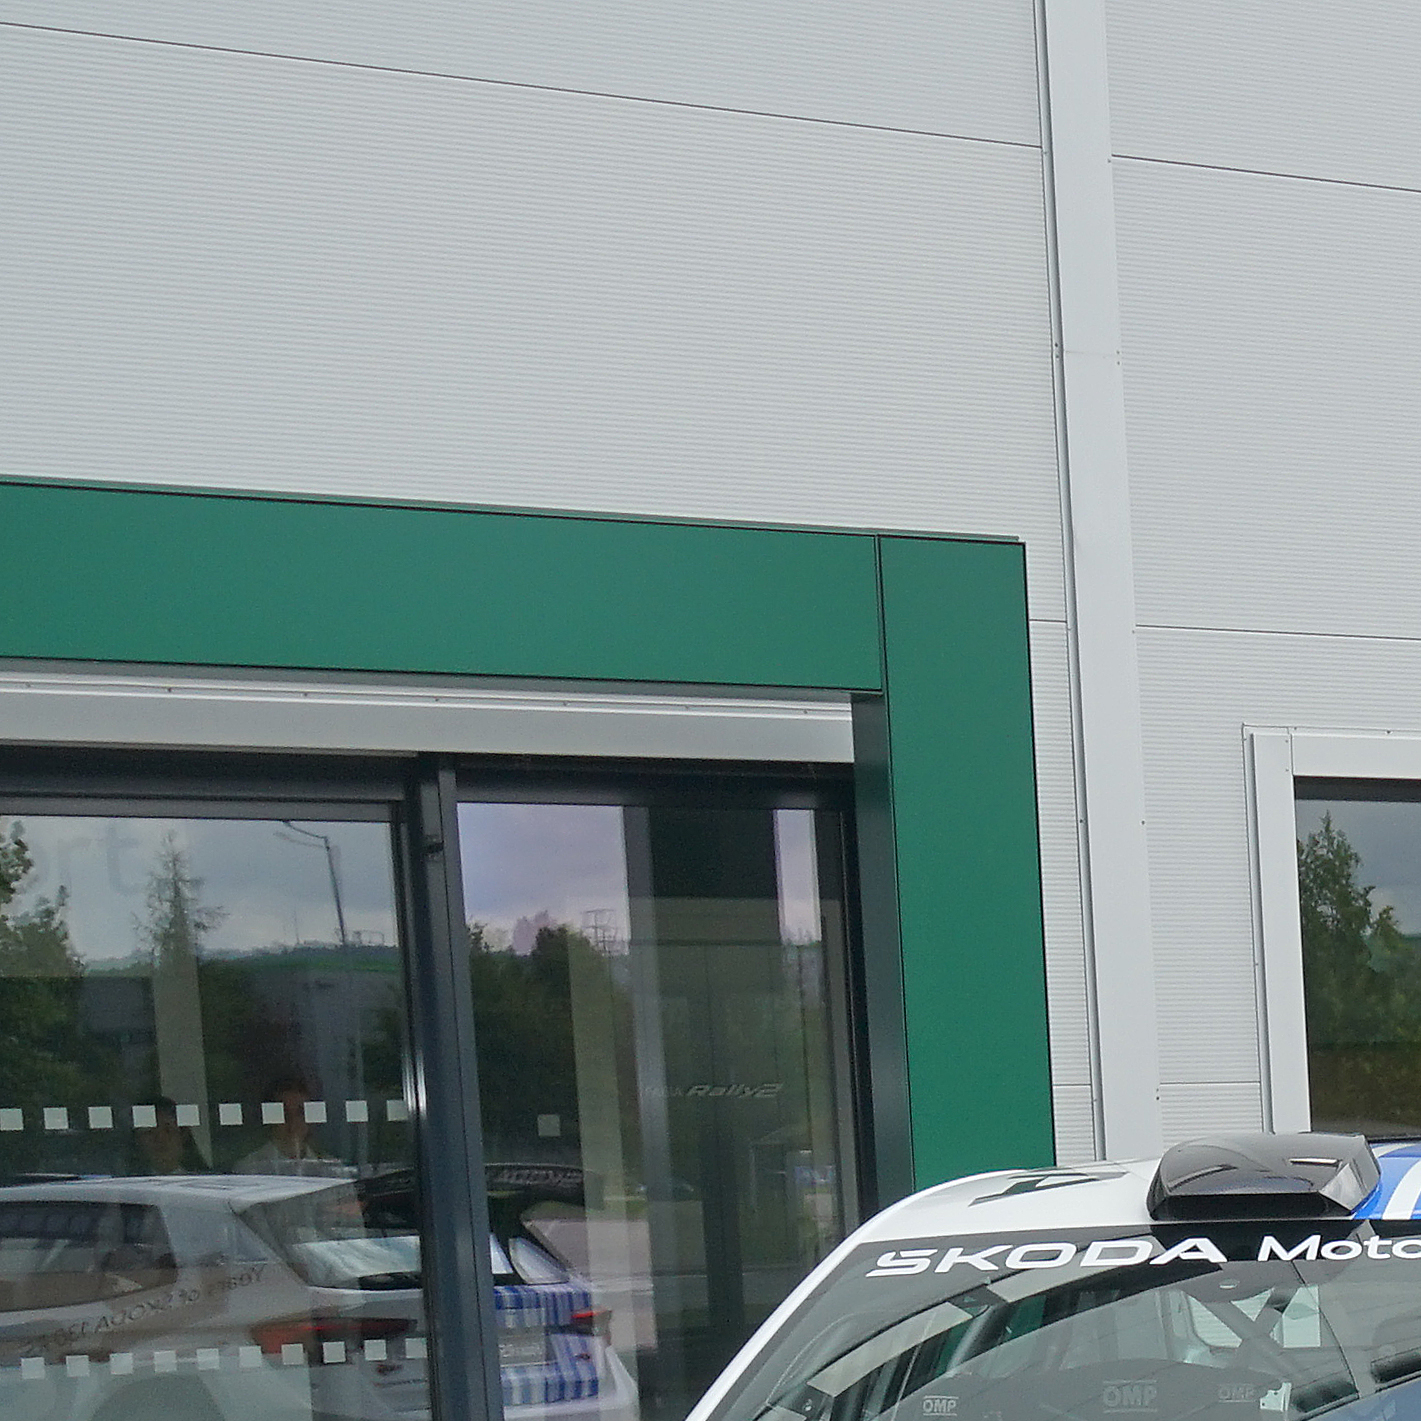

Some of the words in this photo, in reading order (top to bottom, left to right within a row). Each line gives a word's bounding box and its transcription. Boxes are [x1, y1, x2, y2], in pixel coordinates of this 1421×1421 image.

[1103, 1384, 1158, 1408] OMP
[1218, 1384, 1255, 1400] OMP
[922, 1398, 957, 1414] OMP
